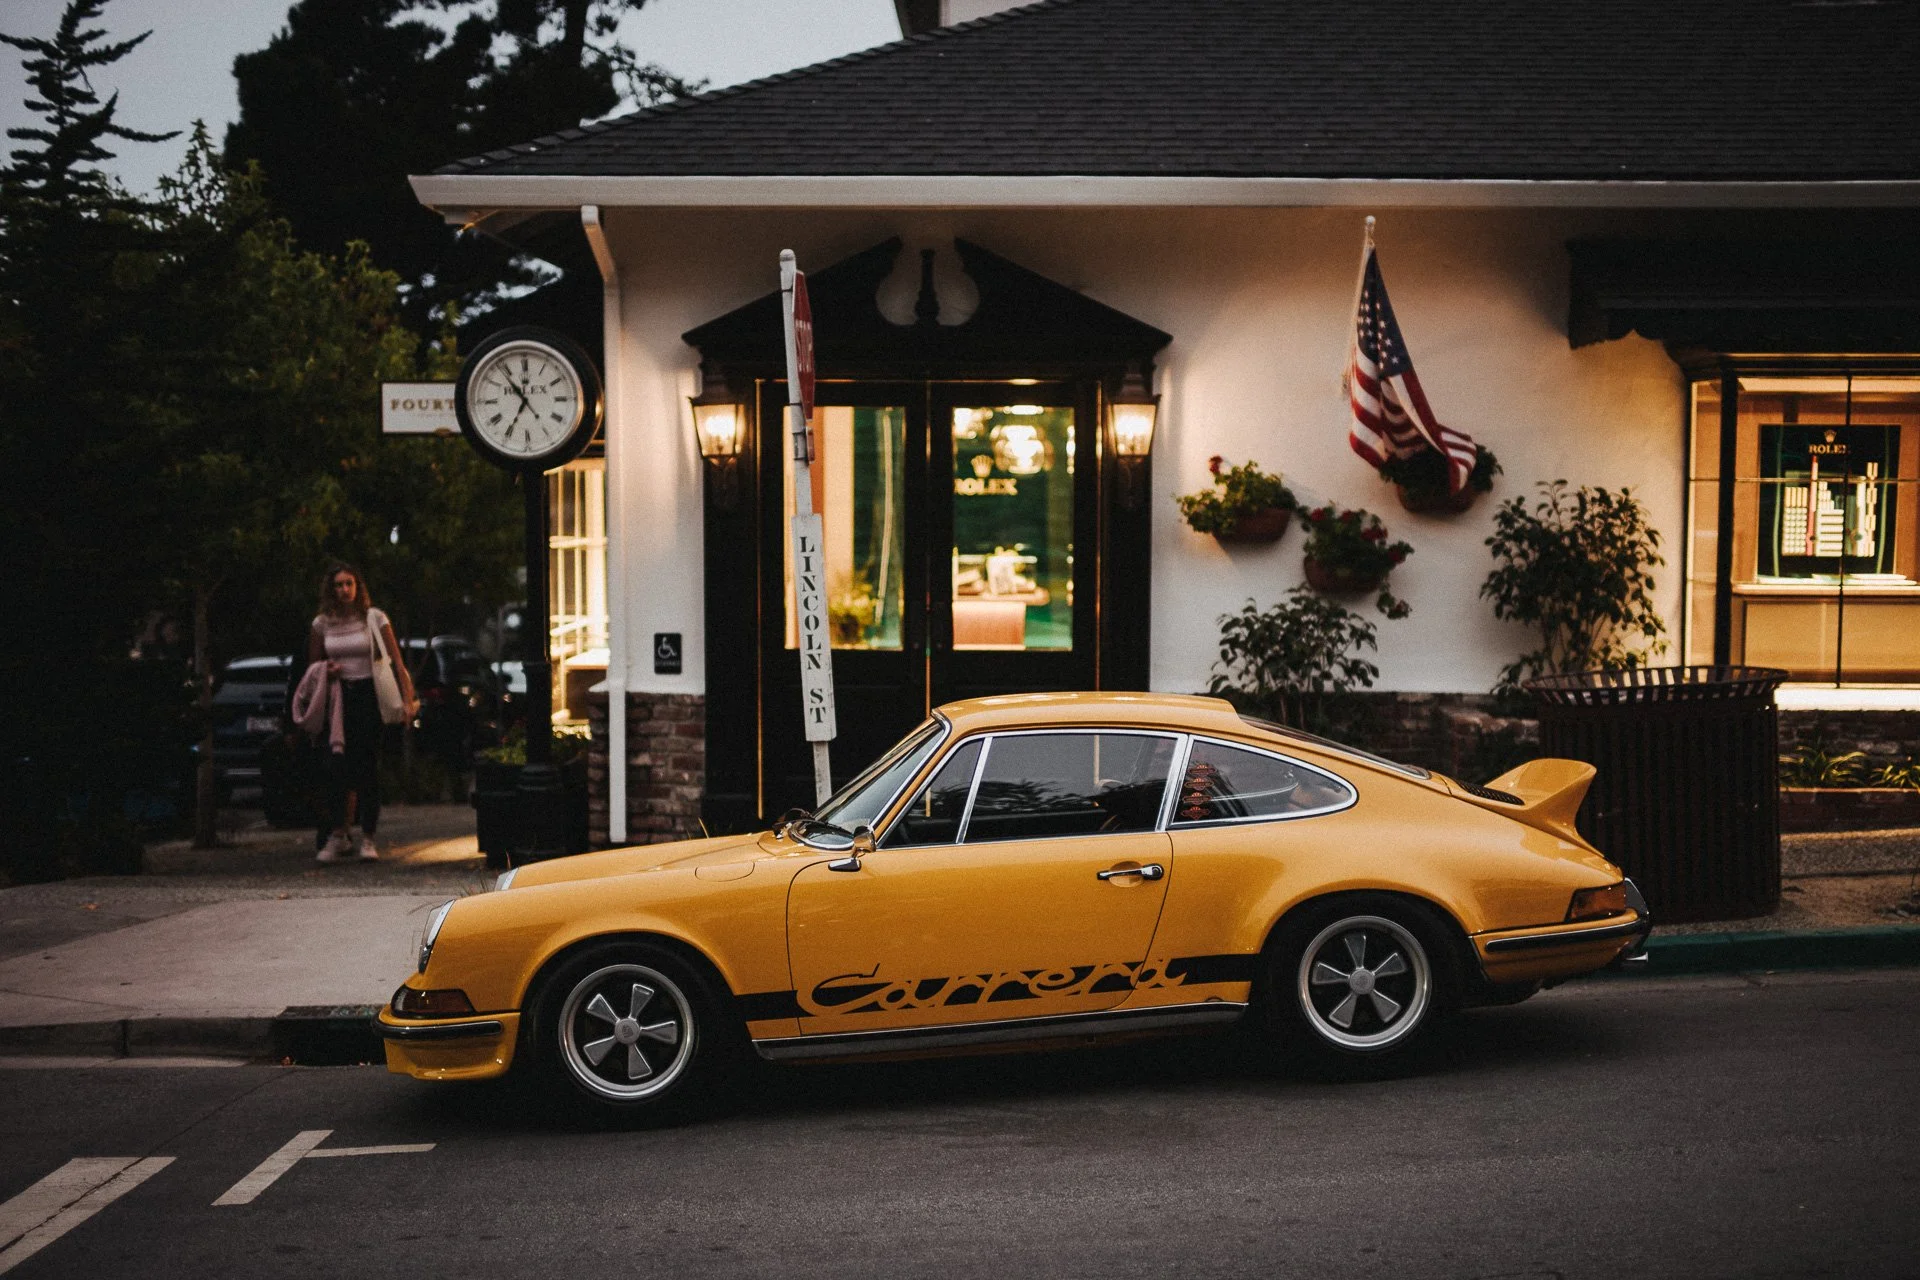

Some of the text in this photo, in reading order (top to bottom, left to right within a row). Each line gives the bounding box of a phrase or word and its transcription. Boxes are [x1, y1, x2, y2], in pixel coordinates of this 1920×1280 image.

[503, 385, 547, 396] RLEX
[799, 536, 826, 724] LINCOLN ST
[796, 957, 1187, 1018] Carrera
